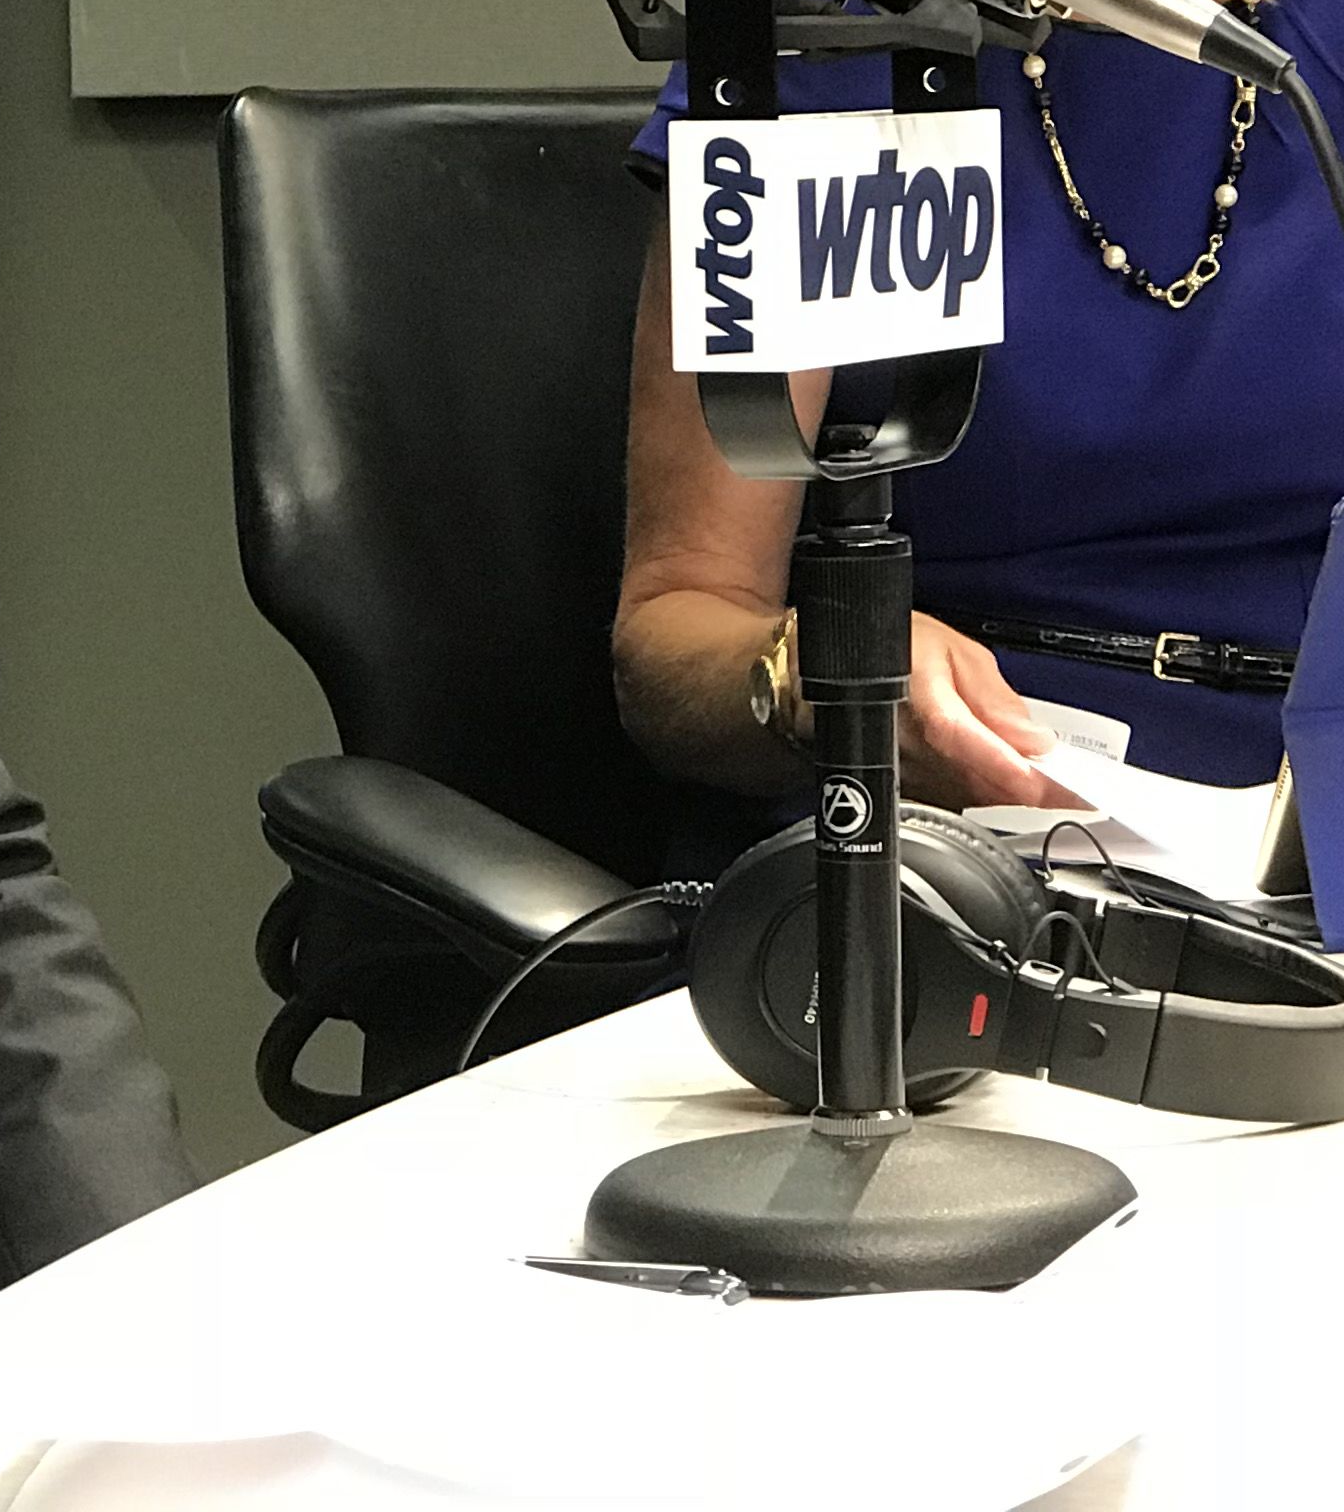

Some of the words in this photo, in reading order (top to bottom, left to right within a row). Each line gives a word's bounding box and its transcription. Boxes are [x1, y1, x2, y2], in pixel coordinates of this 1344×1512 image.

[695, 136, 766, 356] wtop
[796, 148, 995, 318] wtop
[839, 841, 883, 853] Sound
